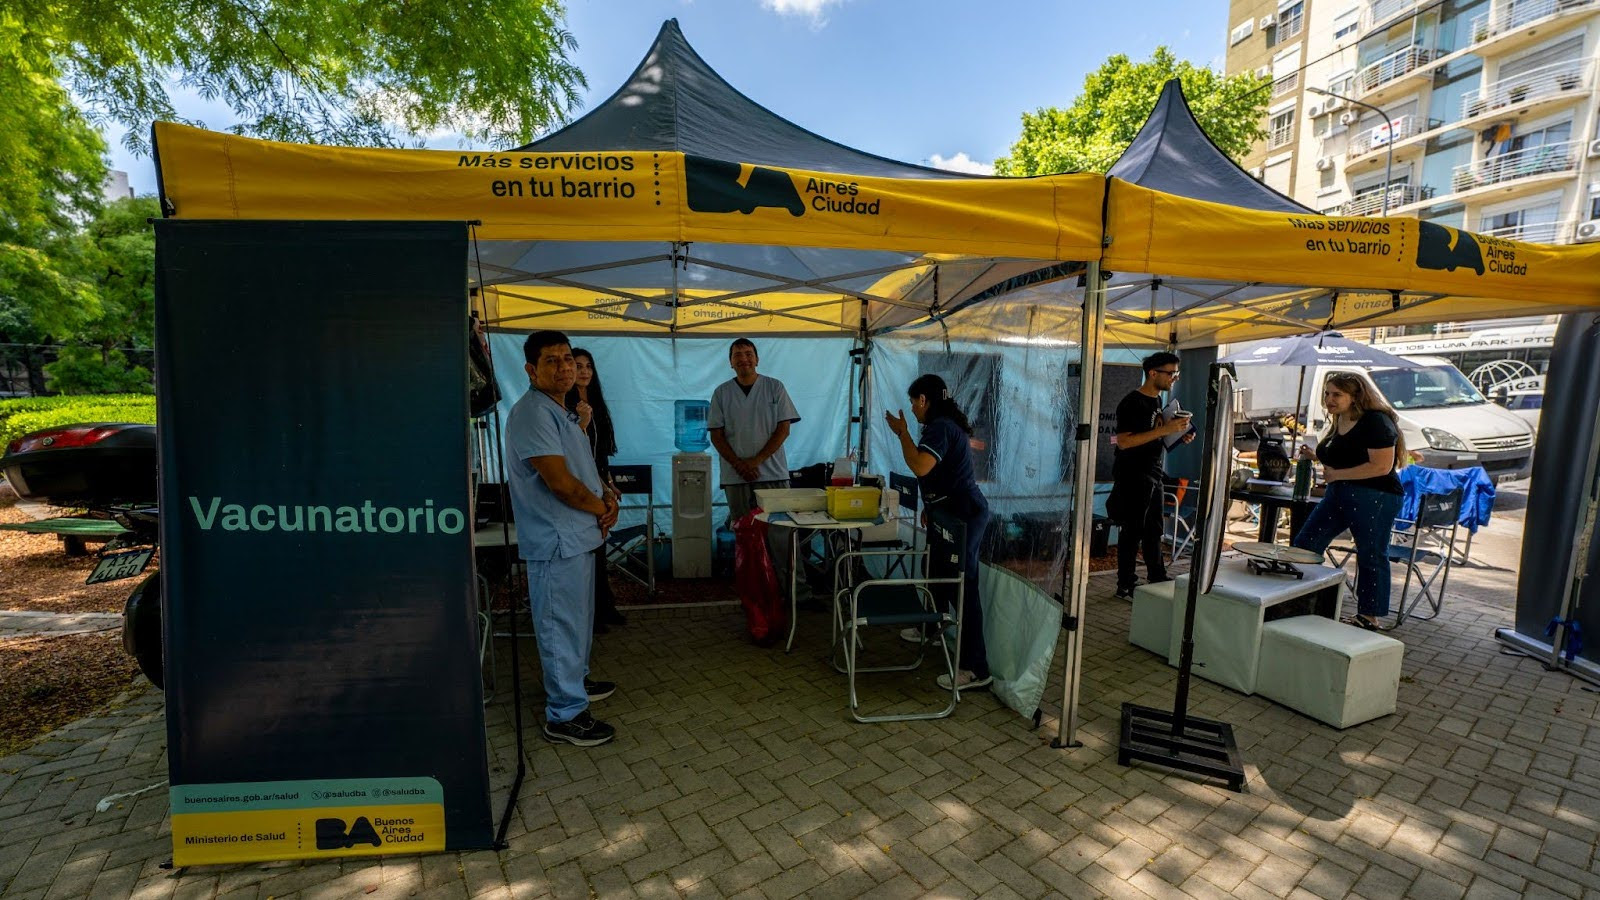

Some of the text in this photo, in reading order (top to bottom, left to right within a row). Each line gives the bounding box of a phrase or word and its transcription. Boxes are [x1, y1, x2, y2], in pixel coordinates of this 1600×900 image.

[458, 153, 634, 171] Más servicios
[492, 176, 635, 198] en tu barrio
[805, 177, 858, 196] Aires
[812, 195, 880, 215] Ciudad
[1328, 219, 1390, 235] servicios
[1306, 238, 1390, 256] en tu barrio
[1486, 245, 1515, 260] Aires
[1489, 259, 1527, 275] Ciudad
[1471, 339, 1508, 347] PARK
[189, 496, 465, 534] Vacunatorio
[184, 792, 299, 804] buenosaires.gob.ar/salud
[323, 789, 367, 800] @saludba
[383, 788, 425, 797] @saludba
[374, 817, 414, 826] Buenos
[315, 816, 382, 850] BA
[382, 826, 411, 834] Aires
[385, 832, 424, 843] Ciudad
[185, 832, 286, 845] Ministerio de Salud
